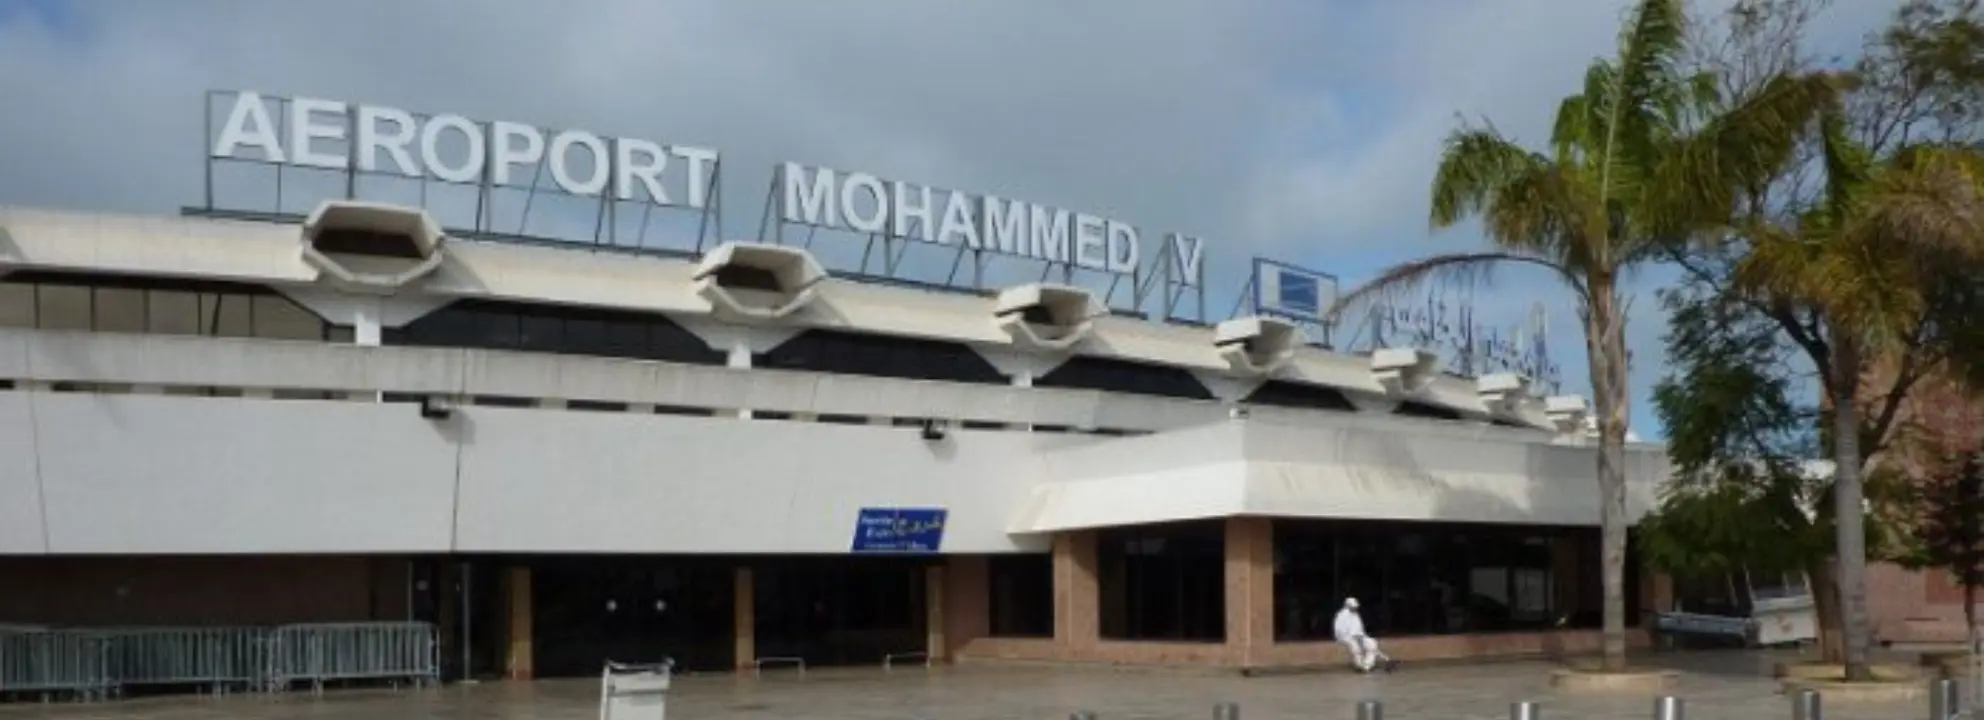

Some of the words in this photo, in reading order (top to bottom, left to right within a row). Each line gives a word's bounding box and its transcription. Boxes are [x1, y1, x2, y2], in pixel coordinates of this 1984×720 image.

[214, 91, 719, 207] AEROPORT
[784, 161, 1140, 275] MOHAMMED
[1174, 232, 1204, 285] V
